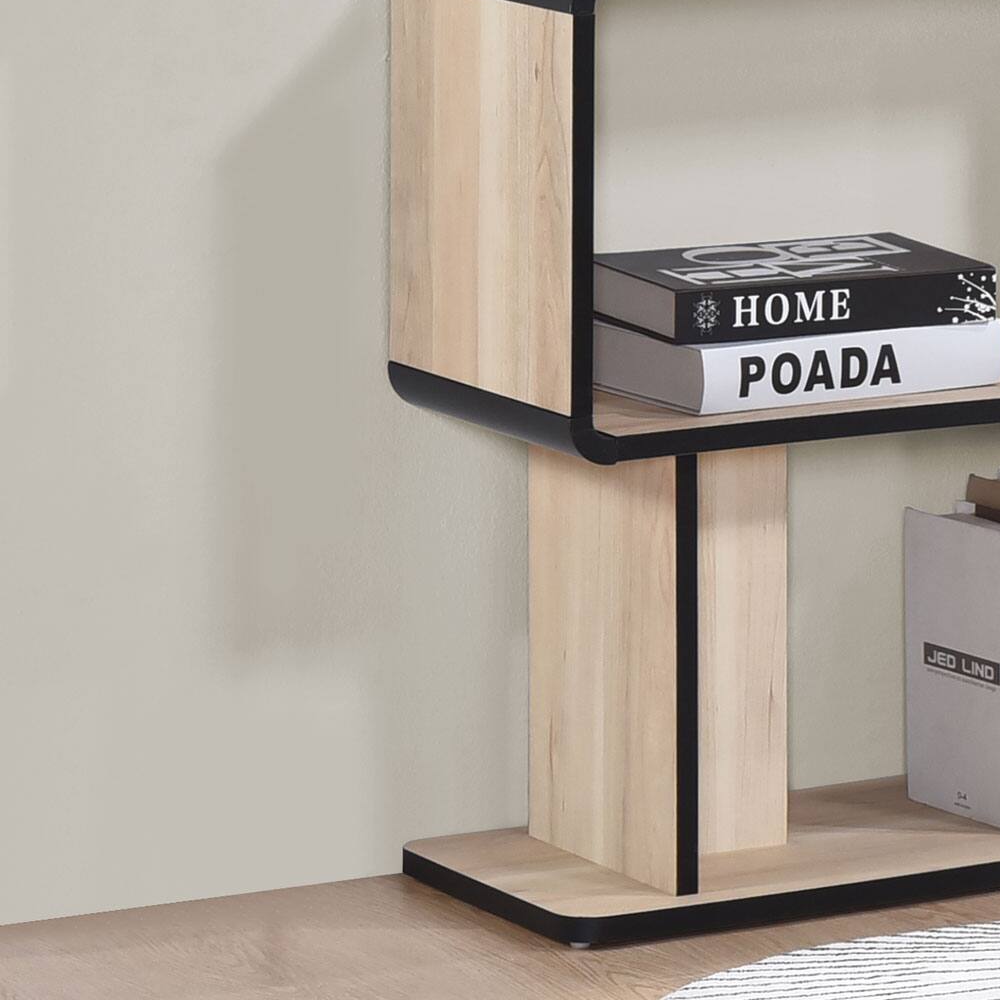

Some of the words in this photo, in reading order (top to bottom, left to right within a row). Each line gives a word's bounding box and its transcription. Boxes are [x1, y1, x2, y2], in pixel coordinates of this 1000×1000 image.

[732, 288, 852, 329] HOME
[739, 343, 902, 398] POADA
[927, 650, 956, 669] JED
[961, 658, 994, 681] LIND
